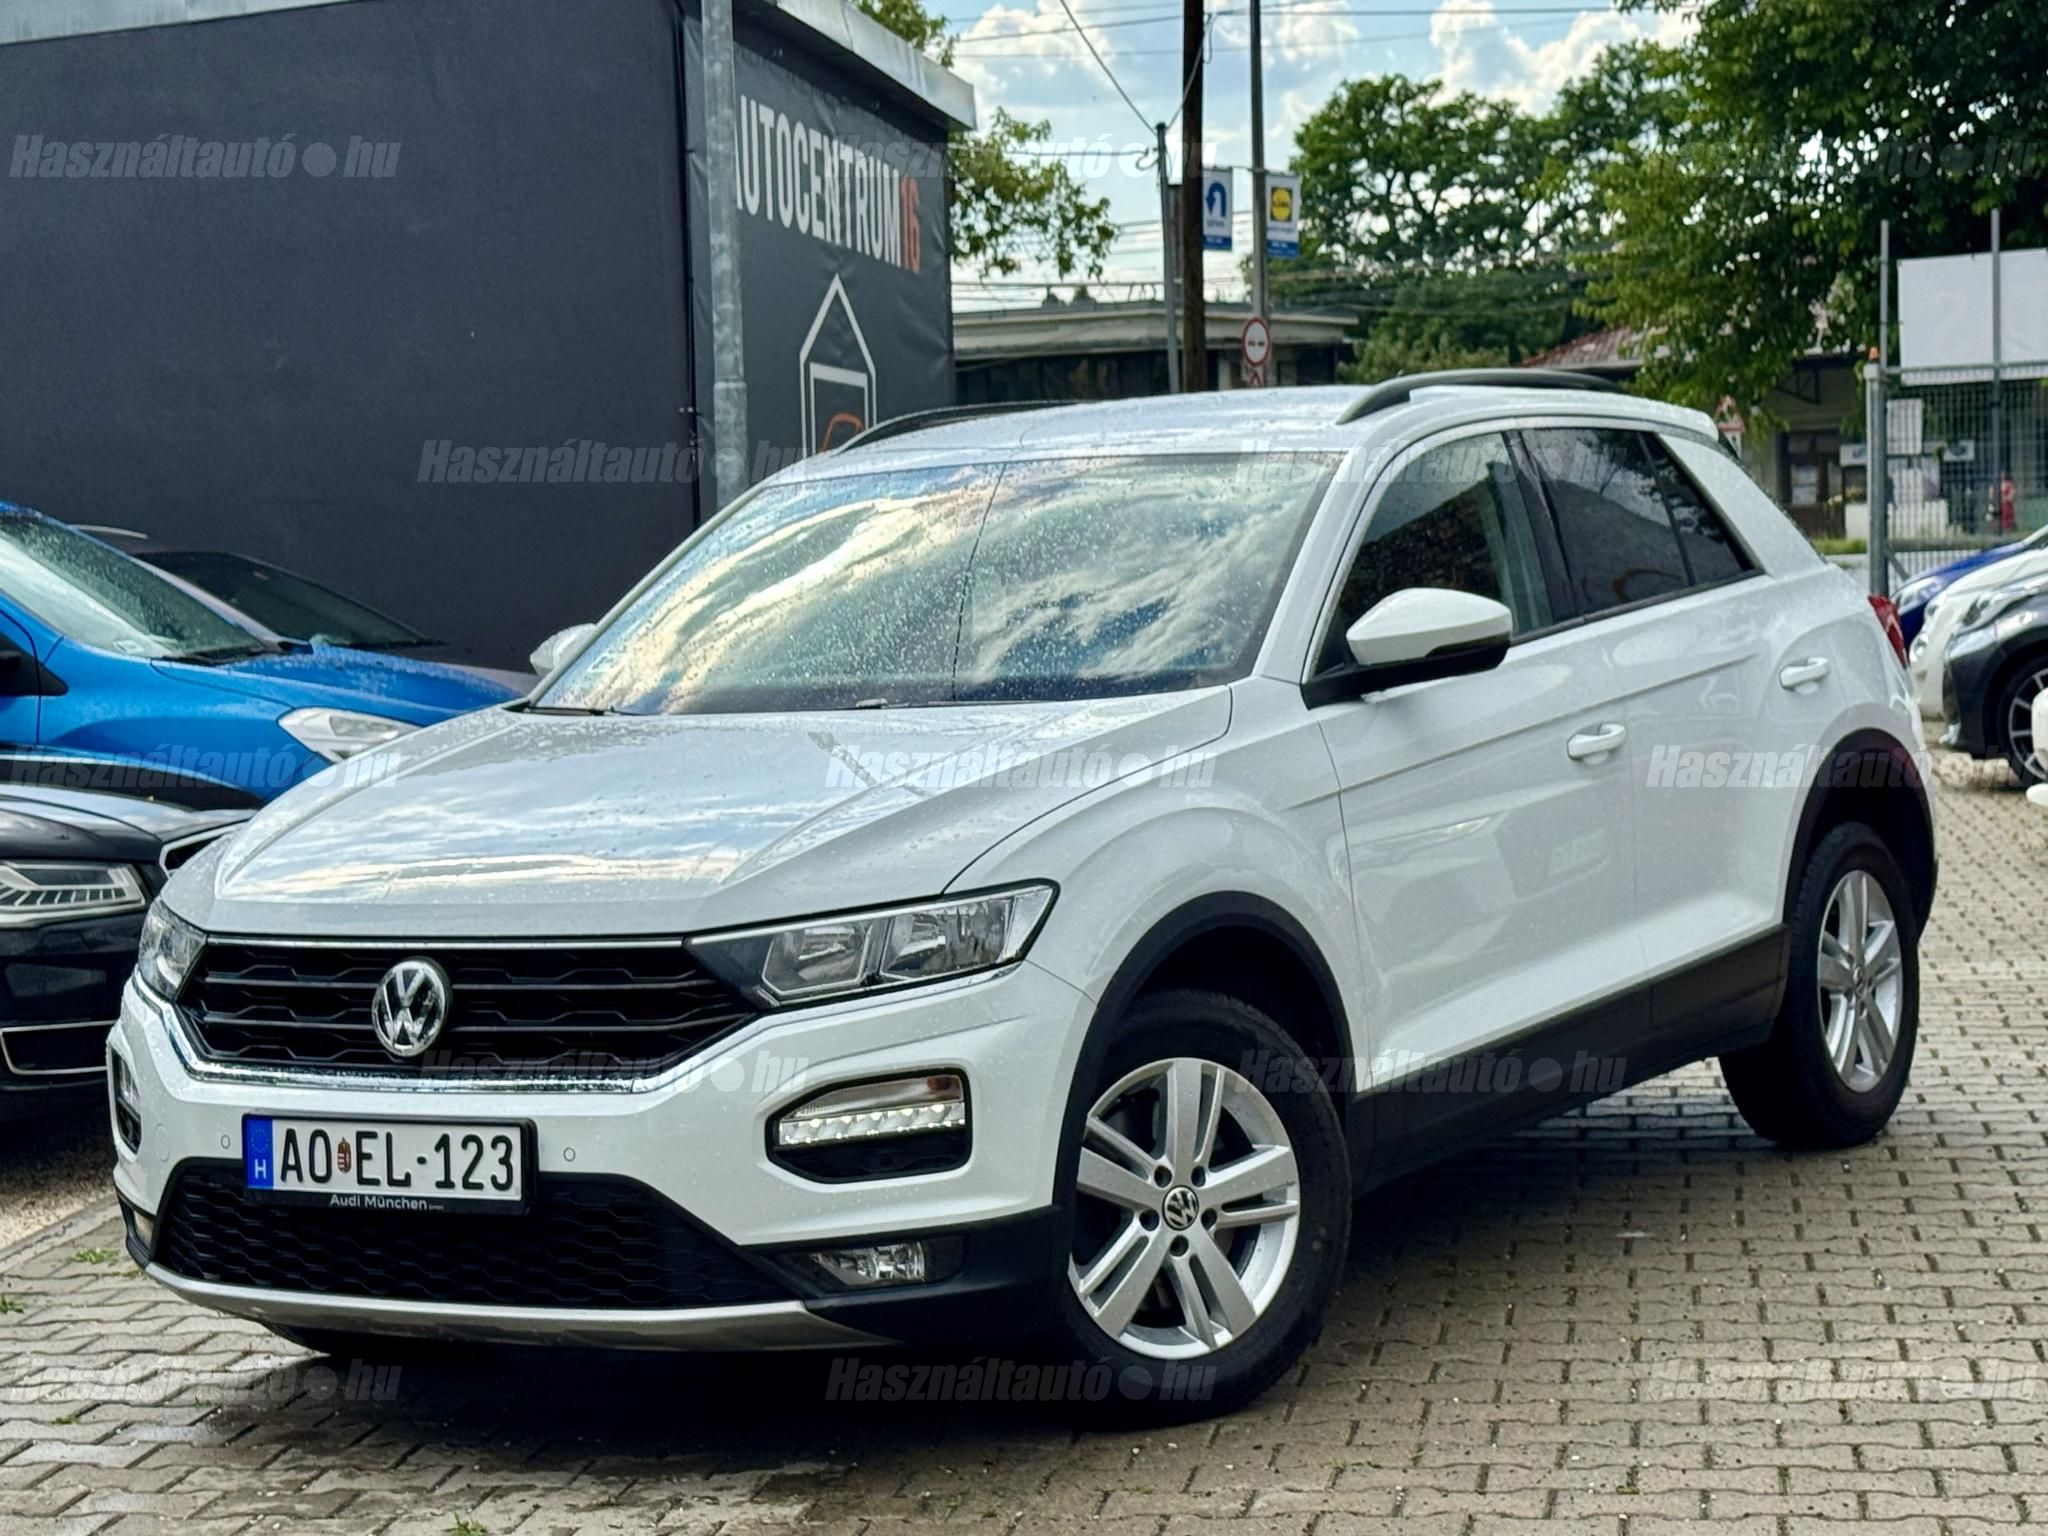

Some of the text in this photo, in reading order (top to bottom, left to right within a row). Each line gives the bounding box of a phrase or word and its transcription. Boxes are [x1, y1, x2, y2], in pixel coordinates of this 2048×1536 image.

[254, 1159, 267, 1180] H
[329, 1194, 361, 1207] Audi
[364, 1195, 428, 1210] München
